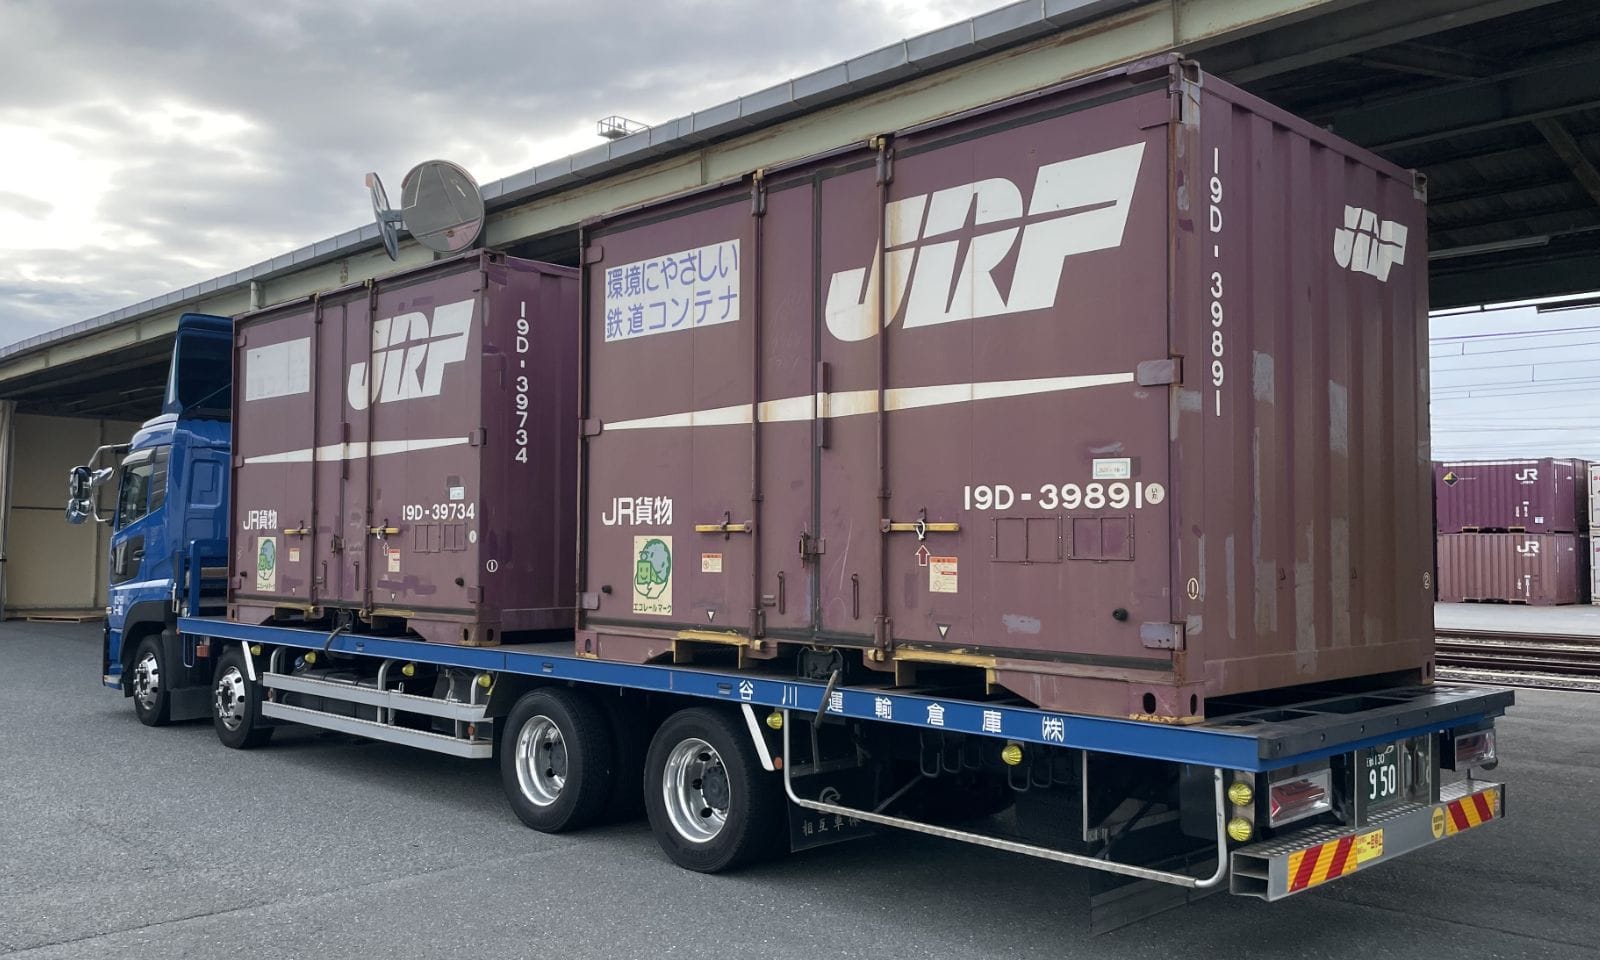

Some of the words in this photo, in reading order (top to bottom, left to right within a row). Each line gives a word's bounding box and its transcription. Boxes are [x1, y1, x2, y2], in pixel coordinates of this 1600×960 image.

[825, 142, 1147, 341] JRF
[607, 244, 738, 299] 環境にやさしい
[606, 285, 738, 339] 鉄道コンテナ
[348, 298, 475, 411] JRF
[515, 301, 529, 463] 19D-39734
[1515, 468, 1538, 481] JR
[602, 495, 672, 526] JR貨物
[964, 481, 1142, 511] 19D-39891
[243, 509, 277, 530] JR貨物
[402, 503, 475, 521] 19D-39734
[1517, 541, 1539, 553] JR
[633, 603, 672, 614] エコレールマーク
